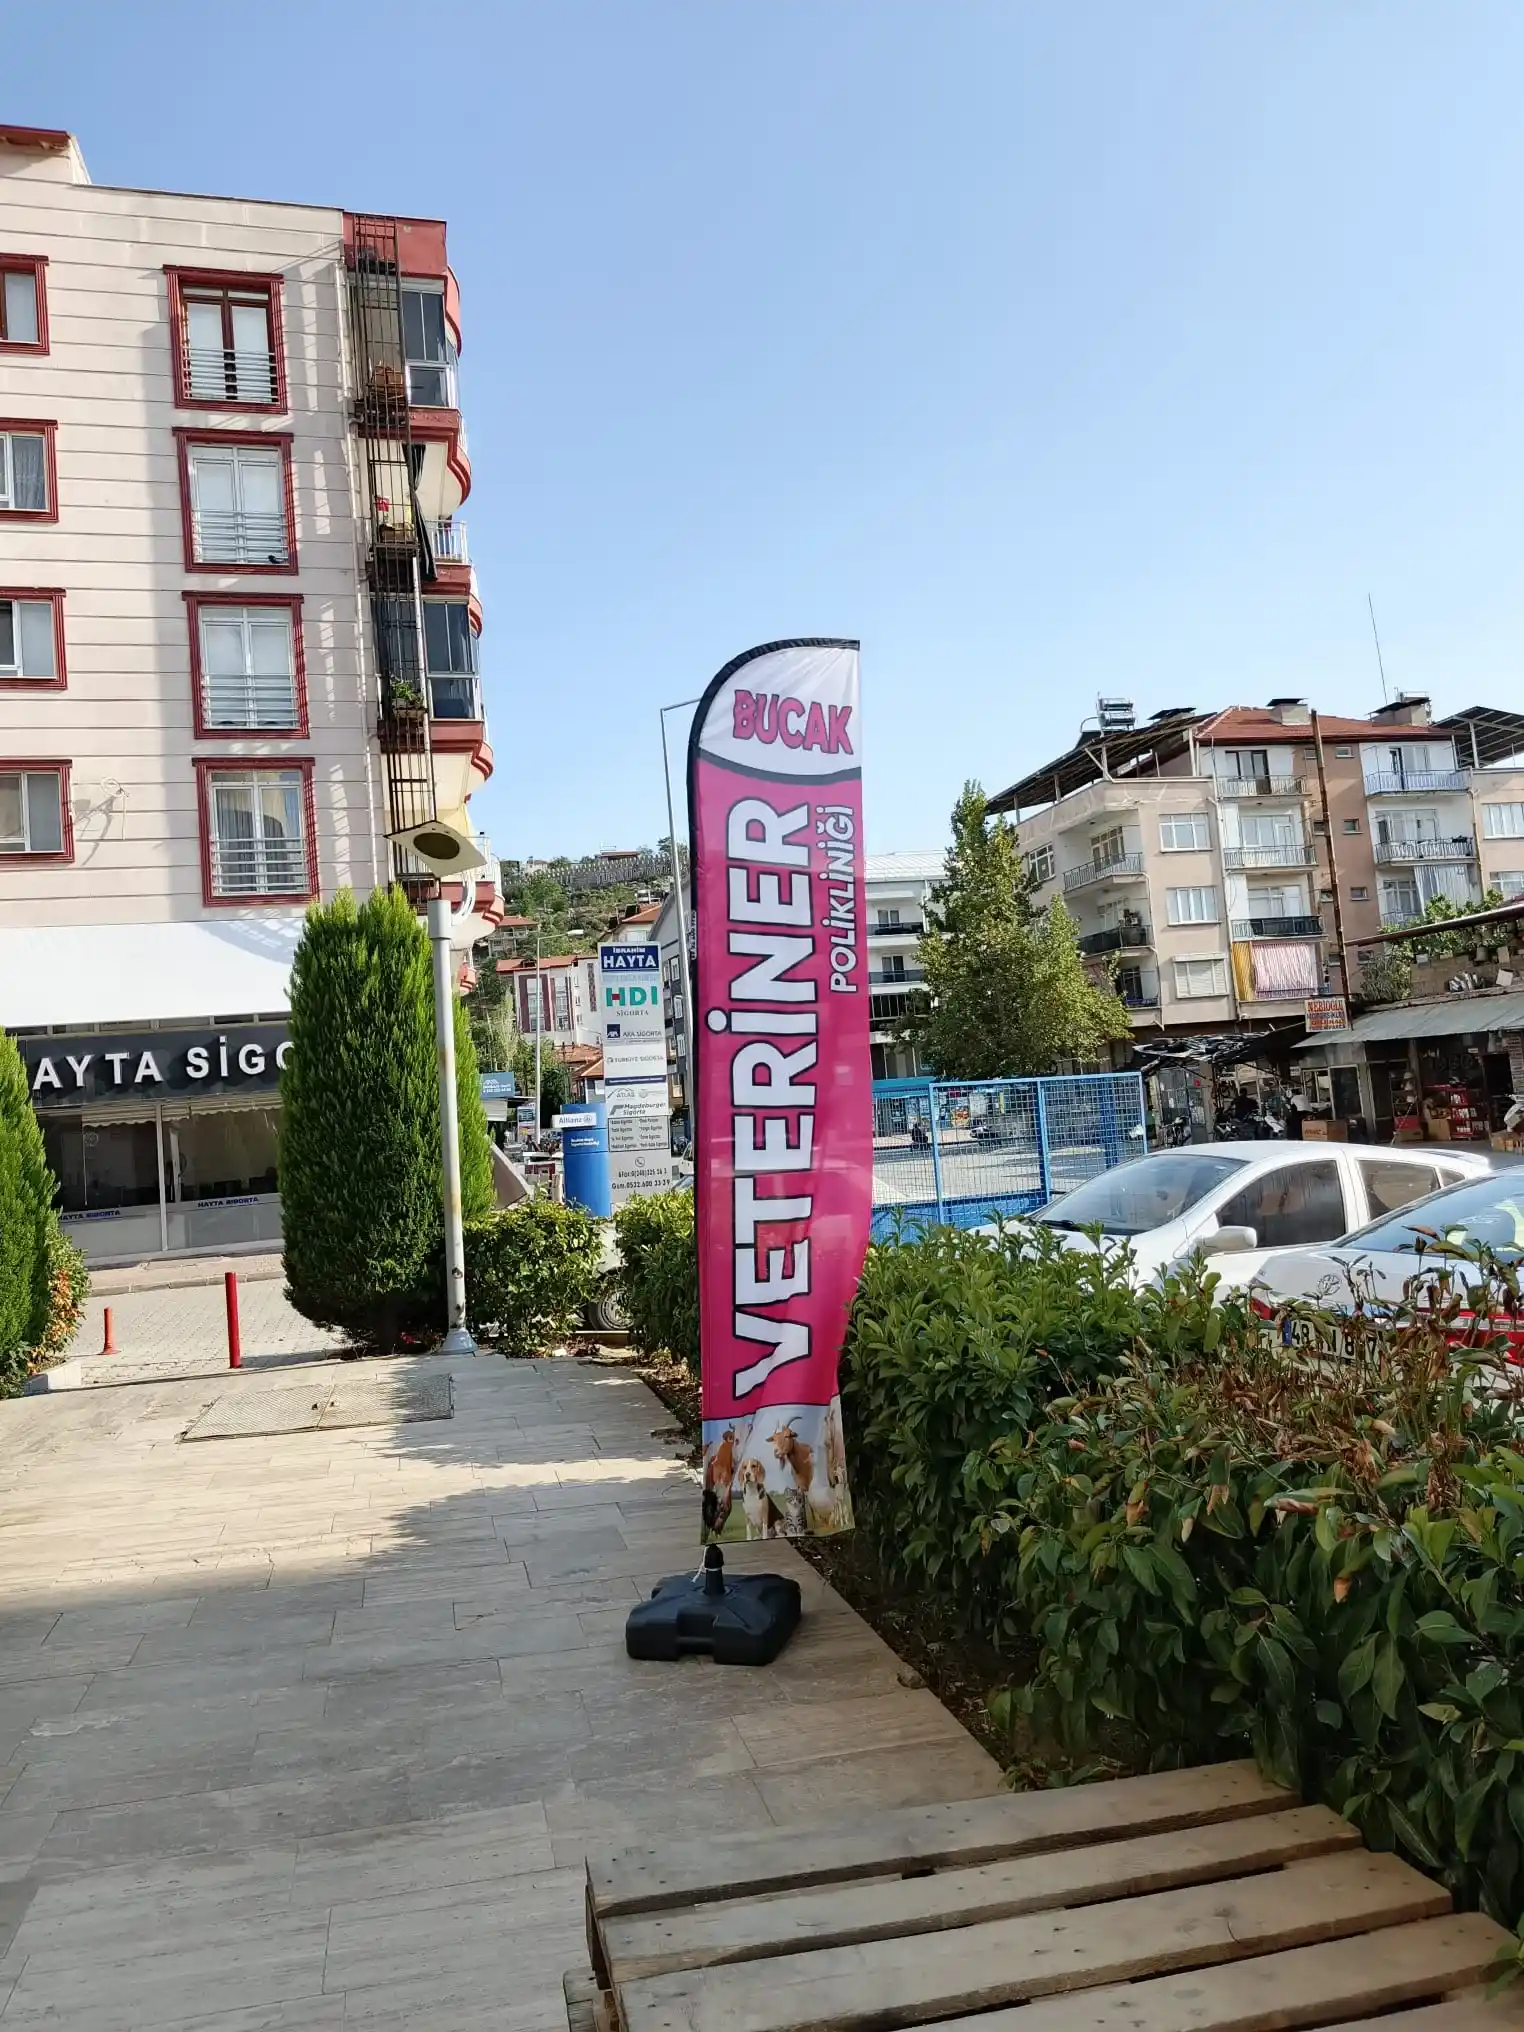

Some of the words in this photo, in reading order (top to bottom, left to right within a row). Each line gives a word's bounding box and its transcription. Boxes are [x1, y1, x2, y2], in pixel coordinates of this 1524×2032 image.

[732, 689, 854, 755] BUCAK
[816, 804, 858, 994] POLİKLİNİĞİ
[603, 955, 657, 968] HAYTA
[605, 986, 658, 1007] HDI
[559, 1116, 582, 1124] Allianz
[706, 797, 819, 1400] VETERİNER
